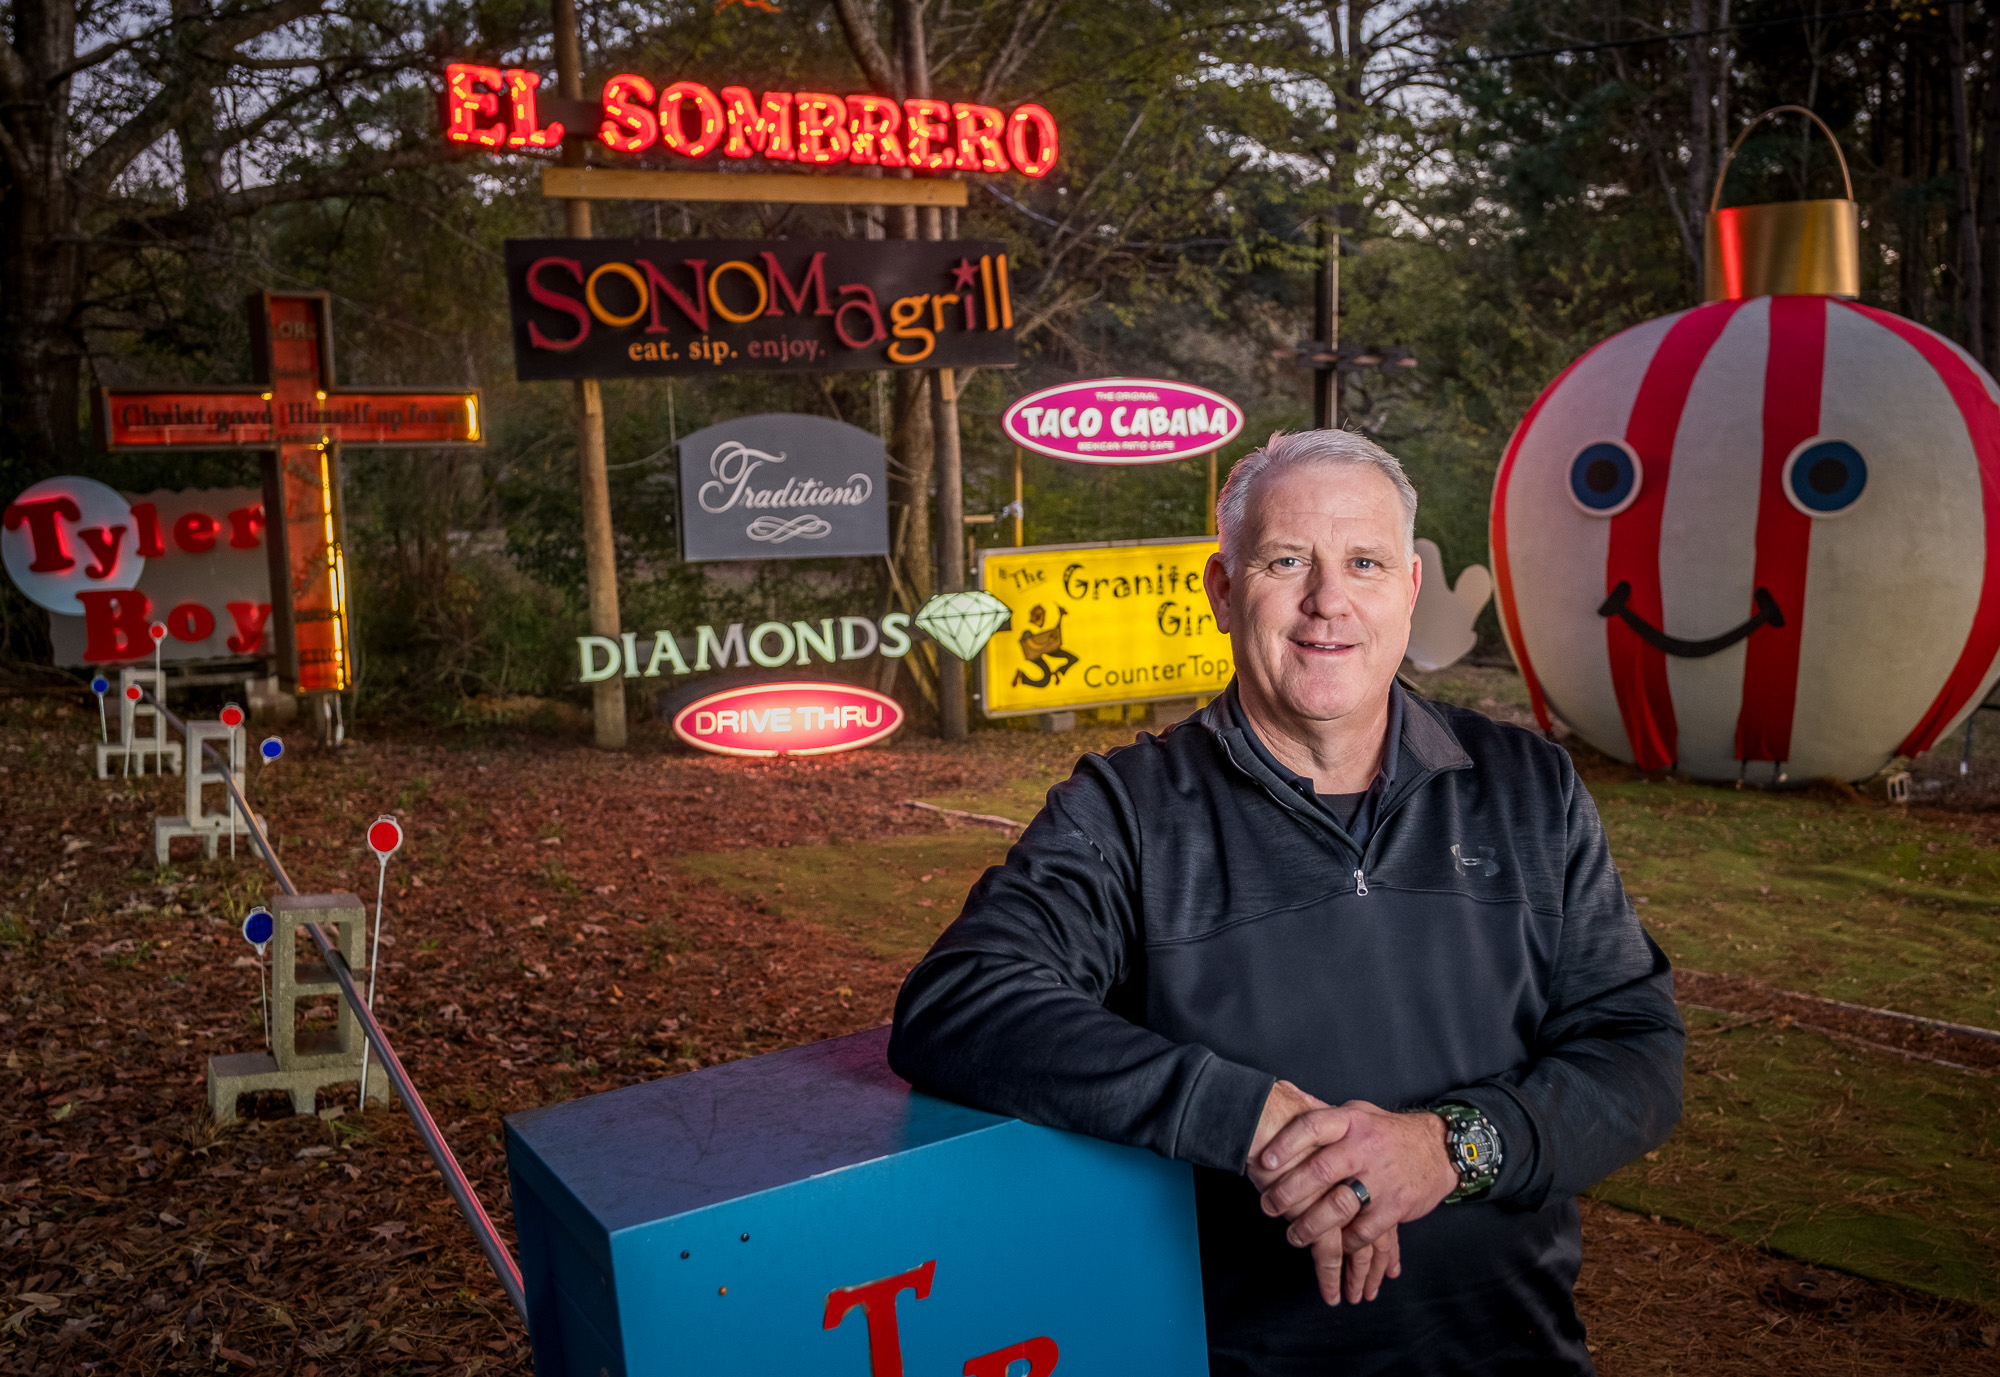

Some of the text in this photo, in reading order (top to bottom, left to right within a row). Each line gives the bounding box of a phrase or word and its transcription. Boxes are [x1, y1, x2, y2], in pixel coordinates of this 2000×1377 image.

[447, 62, 1059, 177] EL SOMBRERO
[628, 335, 827, 365] eat. sip. enjoy.
[122, 403, 204, 426] Christ
[289, 402, 371, 424] Himself
[377, 409, 404, 432] up
[409, 402, 438, 424] for
[1021, 403, 1229, 439] TACO CABANA
[698, 440, 873, 514] Traditions
[3, 495, 266, 580] Tyler
[1063, 562, 1202, 600] Granite
[75, 589, 272, 662] Boy
[1157, 601, 1212, 636] Gir
[576, 612, 912, 683] DIAMONDS
[695, 704, 883, 736] DRIVE THRU
